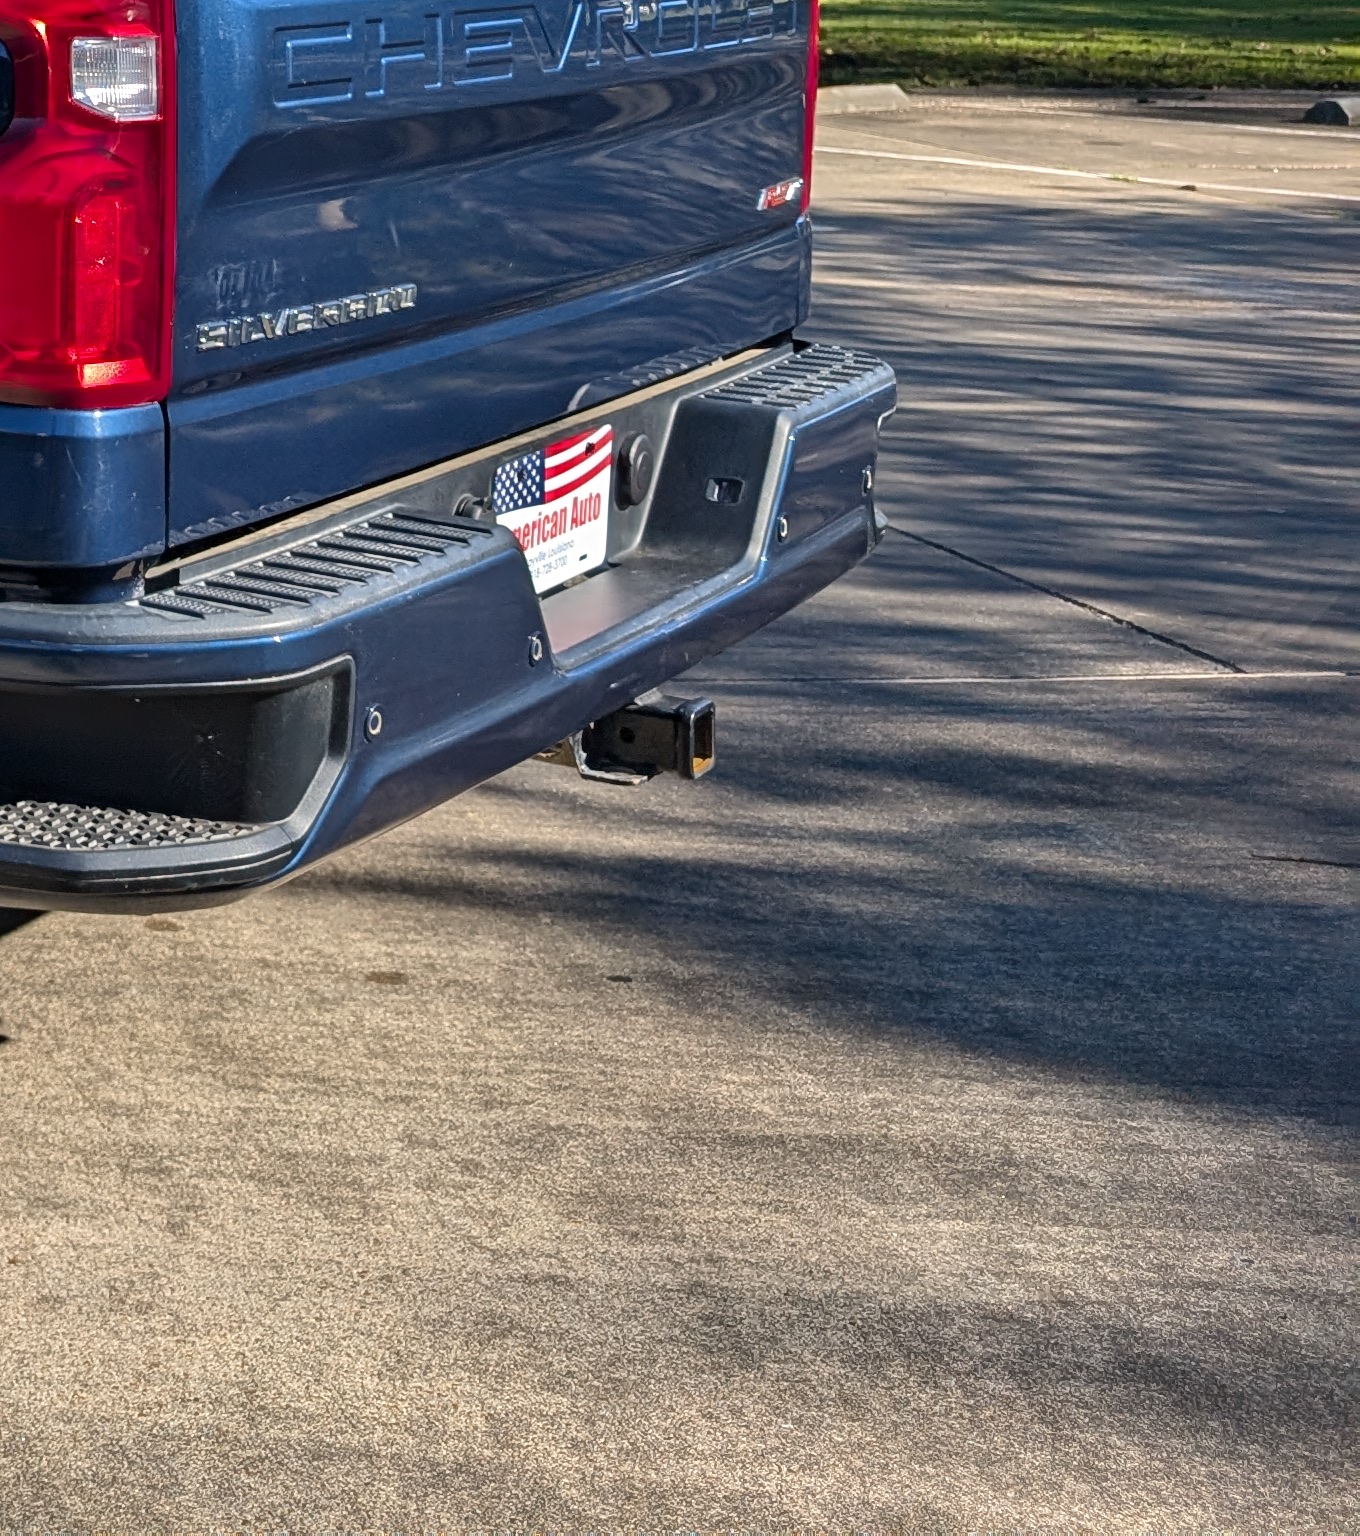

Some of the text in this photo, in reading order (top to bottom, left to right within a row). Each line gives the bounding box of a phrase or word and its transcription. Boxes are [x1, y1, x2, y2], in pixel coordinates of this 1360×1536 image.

[195, 283, 418, 354] SILVERADO
[512, 492, 601, 552] erican Auto
[532, 554, 568, 578] 18-728-3700
